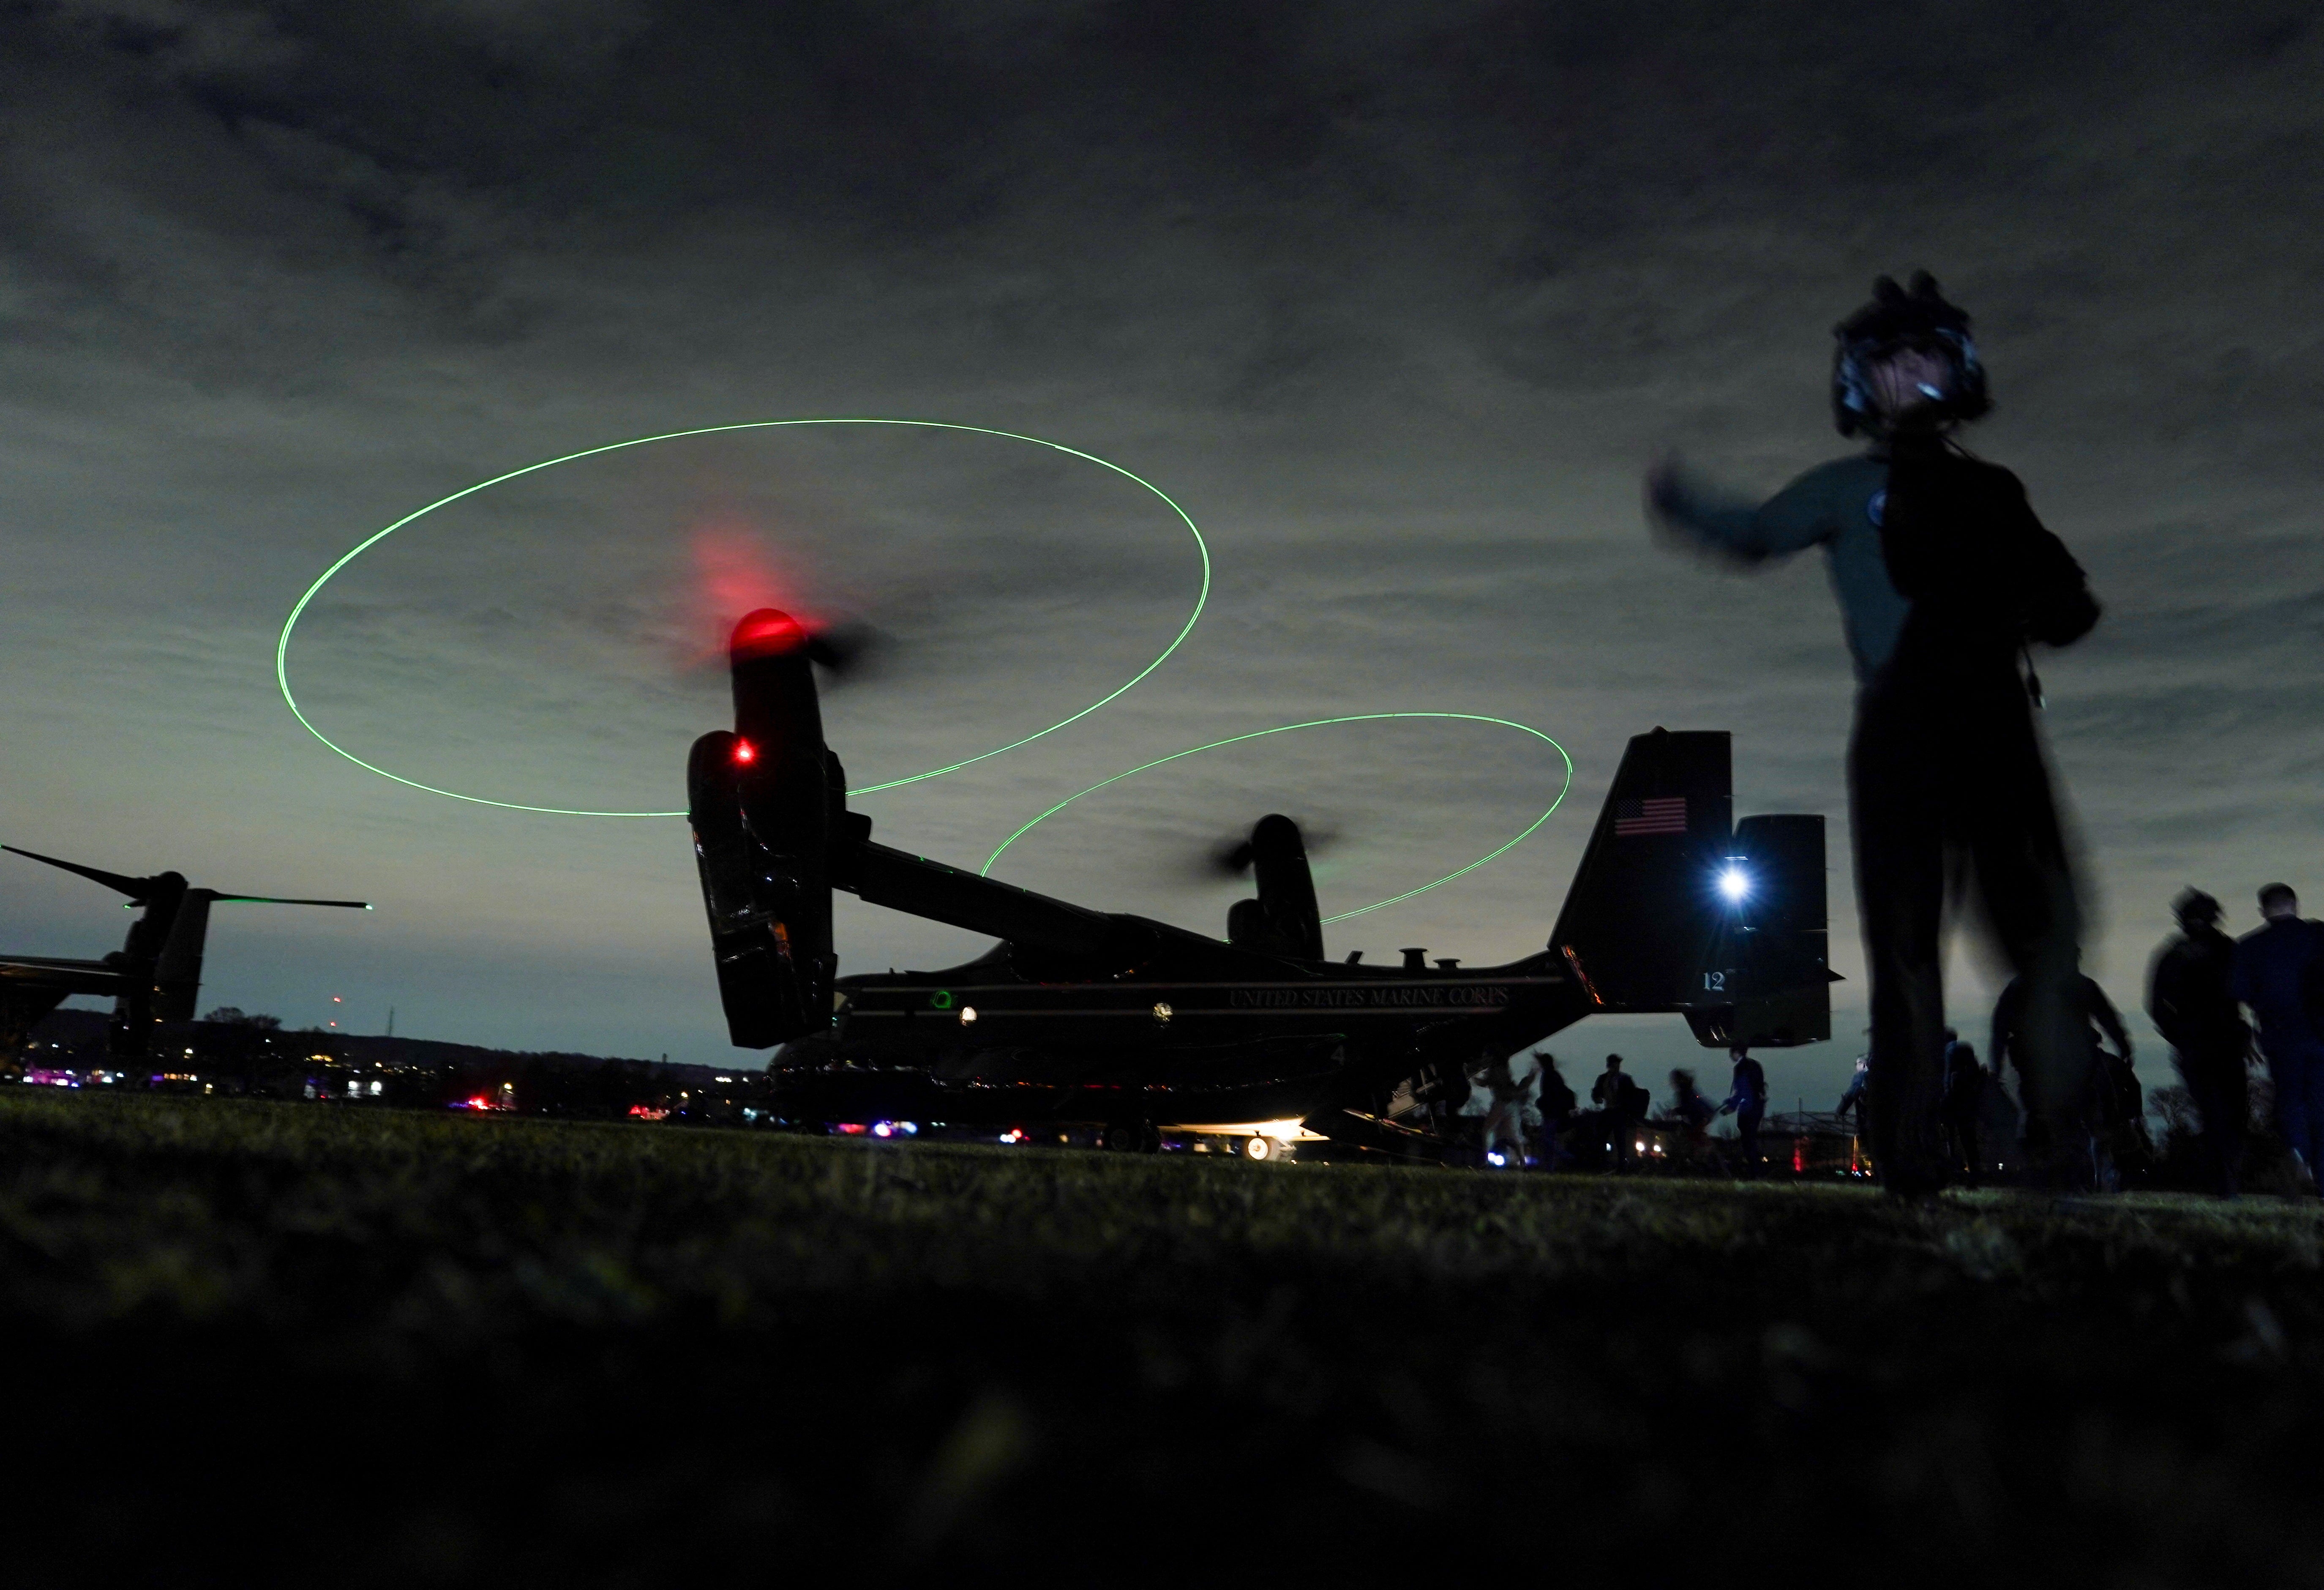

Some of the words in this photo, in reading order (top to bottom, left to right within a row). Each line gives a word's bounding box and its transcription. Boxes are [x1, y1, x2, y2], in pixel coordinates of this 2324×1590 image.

[1703, 972, 1725, 991] 12
[1230, 990, 1298, 1006] UNITED
[1301, 989, 1366, 1006] STATES
[1369, 988, 1445, 1005] MARINE
[1448, 986, 1509, 1004] CORPS
